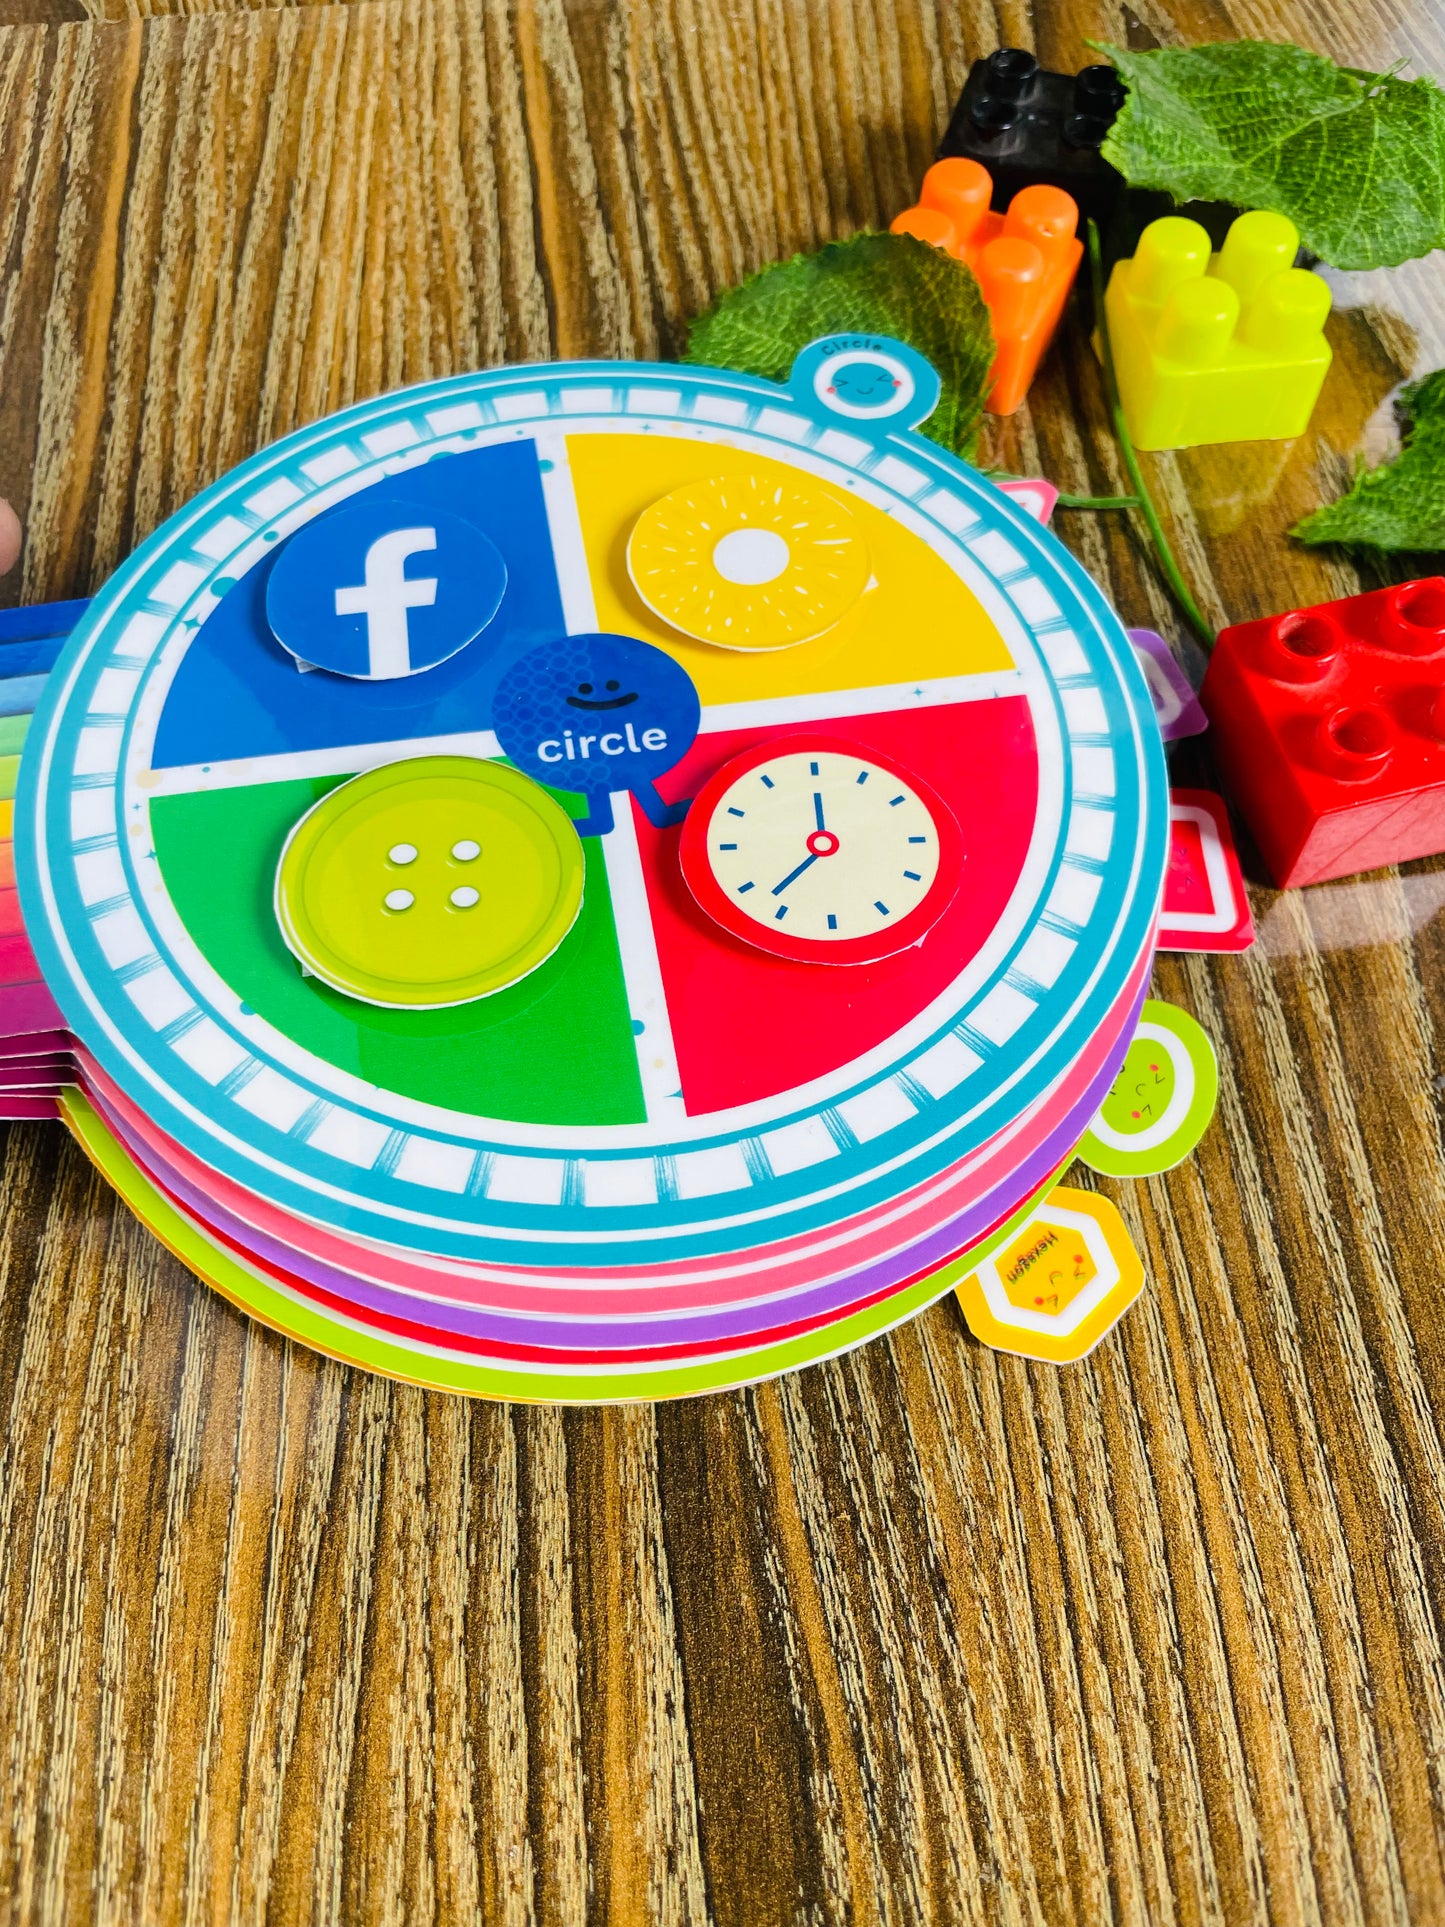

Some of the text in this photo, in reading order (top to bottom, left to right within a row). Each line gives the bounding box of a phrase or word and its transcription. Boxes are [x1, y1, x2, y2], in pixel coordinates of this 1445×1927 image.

[821, 339, 882, 356] Circle
[335, 527, 438, 679] f
[538, 723, 668, 763] circle
[1005, 1230, 1059, 1285] Hexagon
